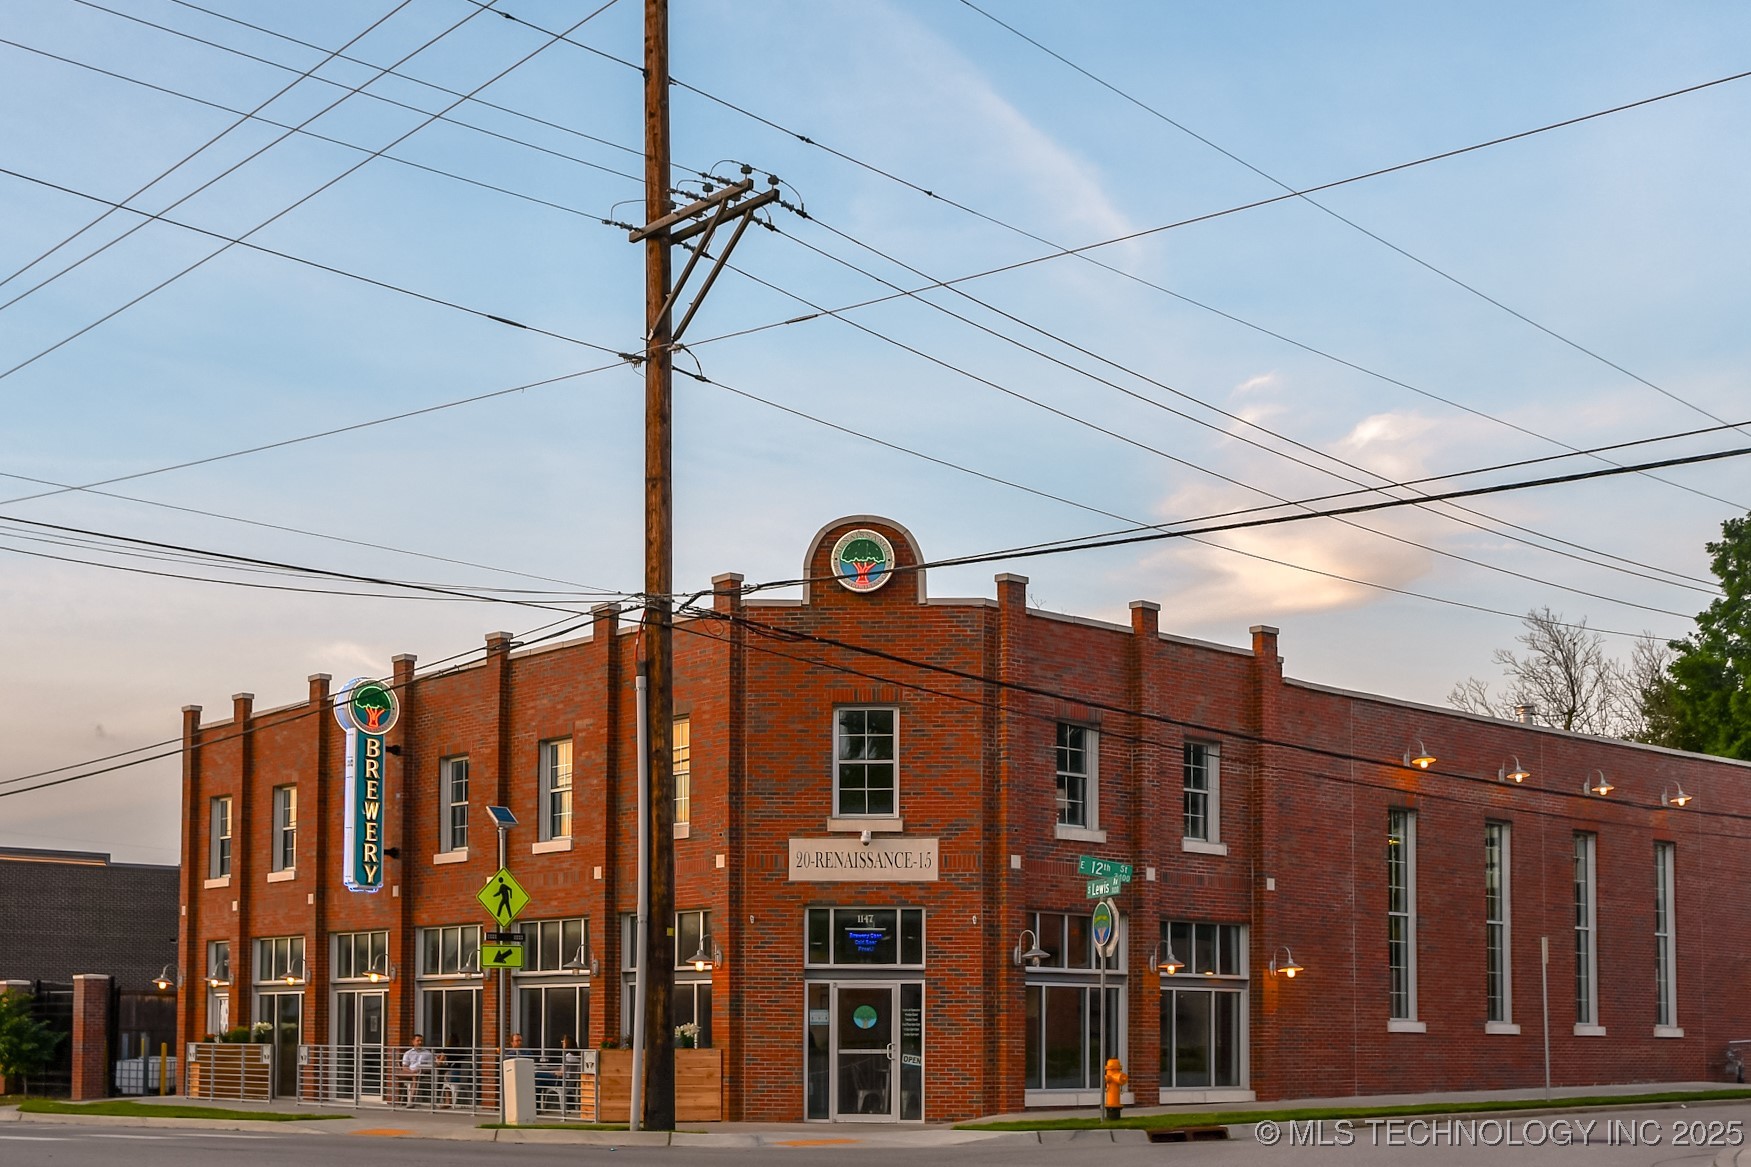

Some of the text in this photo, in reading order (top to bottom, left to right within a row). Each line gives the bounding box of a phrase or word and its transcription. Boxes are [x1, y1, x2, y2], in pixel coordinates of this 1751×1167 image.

[363, 737, 382, 886] BREWERY
[796, 851, 933, 869] 20-RENAISSANCE-15
[1080, 860, 1128, 875] E 12th St
[1092, 880, 1110, 896] Lewis
[903, 1055, 922, 1065] OPEN
